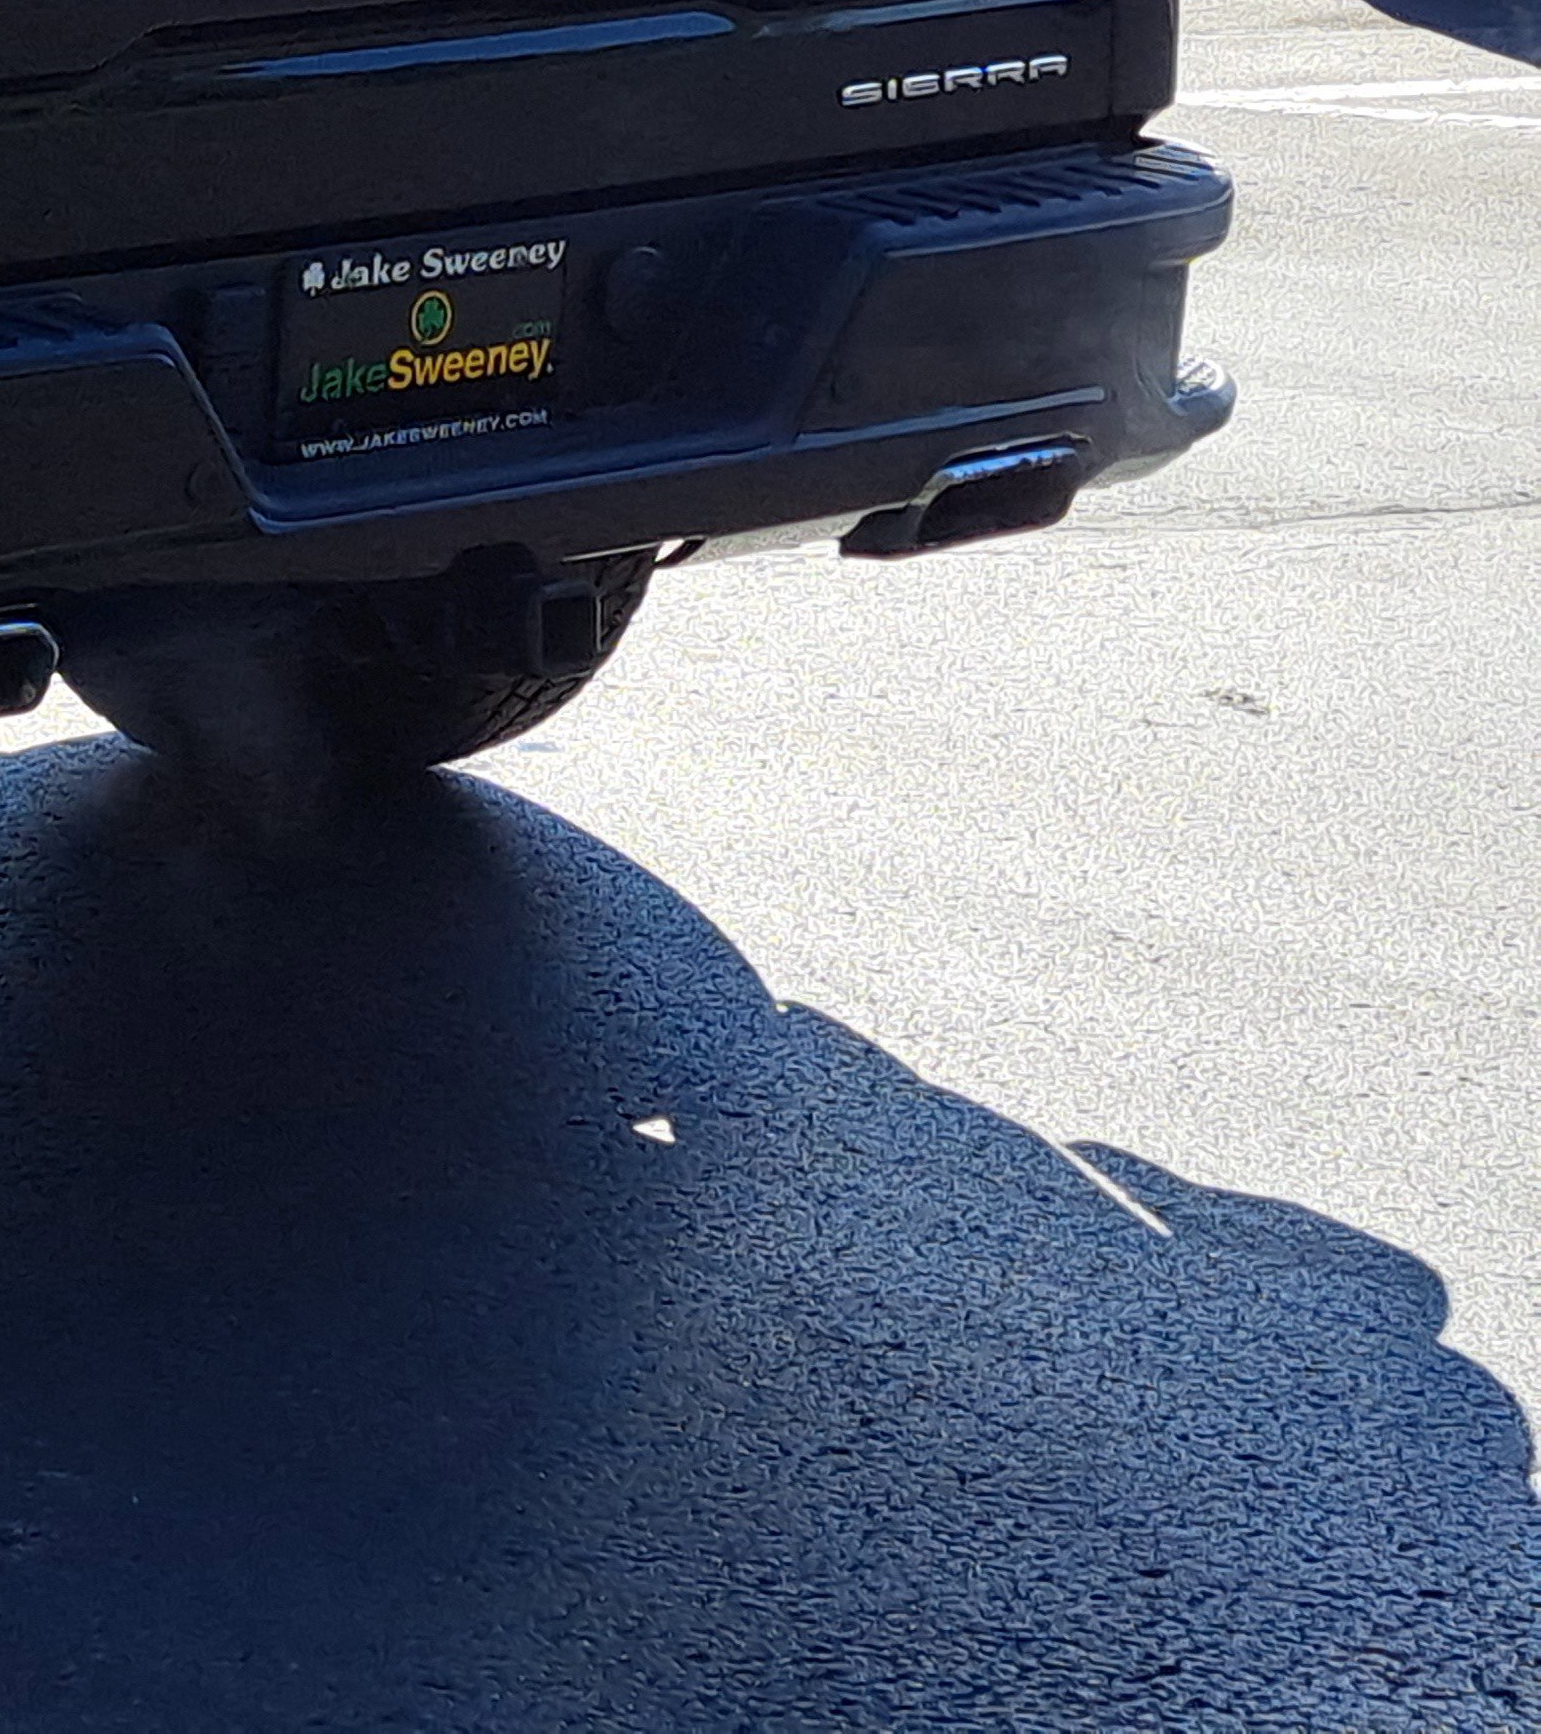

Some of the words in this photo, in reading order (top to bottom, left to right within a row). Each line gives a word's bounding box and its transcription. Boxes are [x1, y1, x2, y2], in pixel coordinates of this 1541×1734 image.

[839, 53, 1069, 107] SIERRA
[330, 252, 412, 290] Jake
[420, 239, 567, 280] Sweeney
